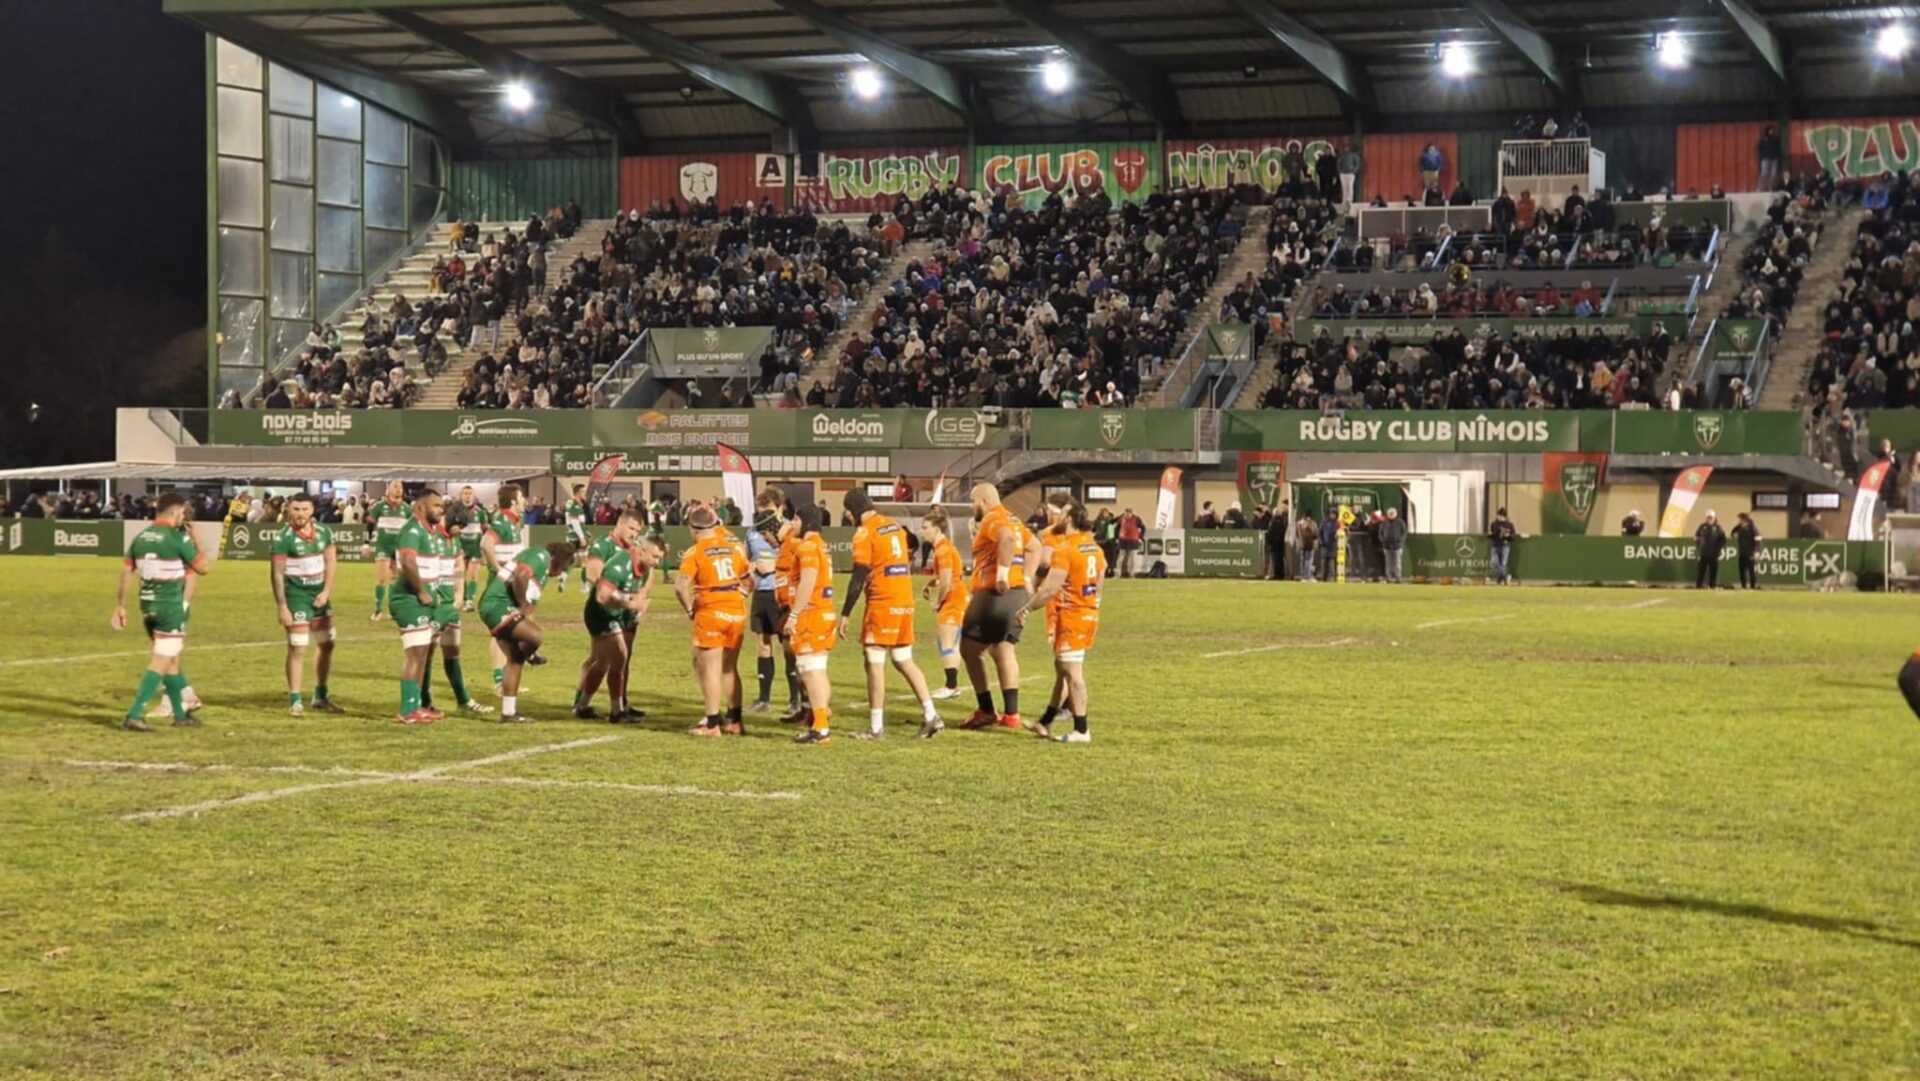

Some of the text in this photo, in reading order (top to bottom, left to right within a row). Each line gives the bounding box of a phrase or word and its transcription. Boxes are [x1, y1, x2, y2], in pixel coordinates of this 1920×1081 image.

[826, 140, 1336, 200] RUGBY CLUB NÎMOS
[262, 411, 352, 429] nova-bois
[812, 412, 884, 435] Weldom
[1300, 413, 1549, 441] RUGBY CLUB NÎMOIS
[566, 461, 584, 470] DES
[54, 529, 98, 547] Buesa
[891, 535, 903, 559] 4
[1624, 546, 1696, 560] BANQUE
[712, 557, 736, 581] 16
[1087, 555, 1097, 578] 8
[1771, 563, 1799, 575] SUD
